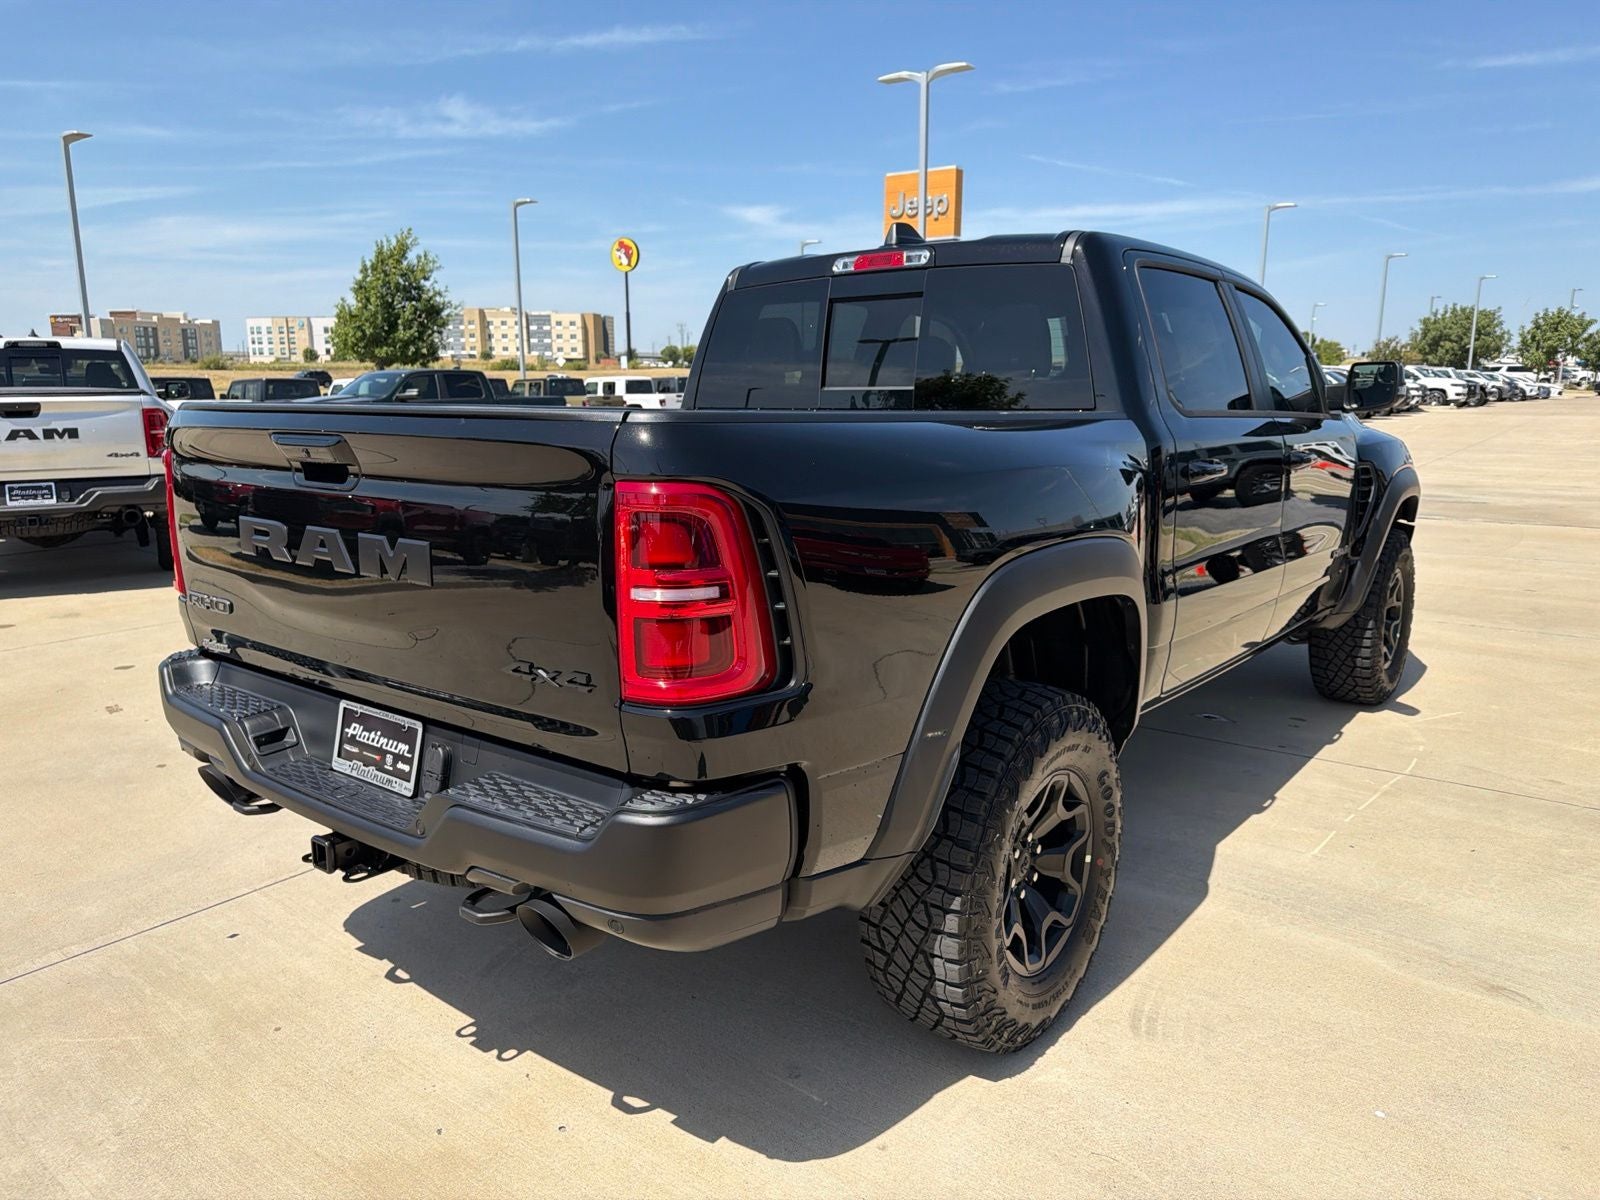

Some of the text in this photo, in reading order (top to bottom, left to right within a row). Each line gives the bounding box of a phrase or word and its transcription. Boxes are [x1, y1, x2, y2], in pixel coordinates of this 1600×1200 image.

[0, 427, 80, 441] AM
[239, 514, 433, 587] RAM
[344, 722, 413, 758] Platinum
[350, 762, 398, 789] Platinum
